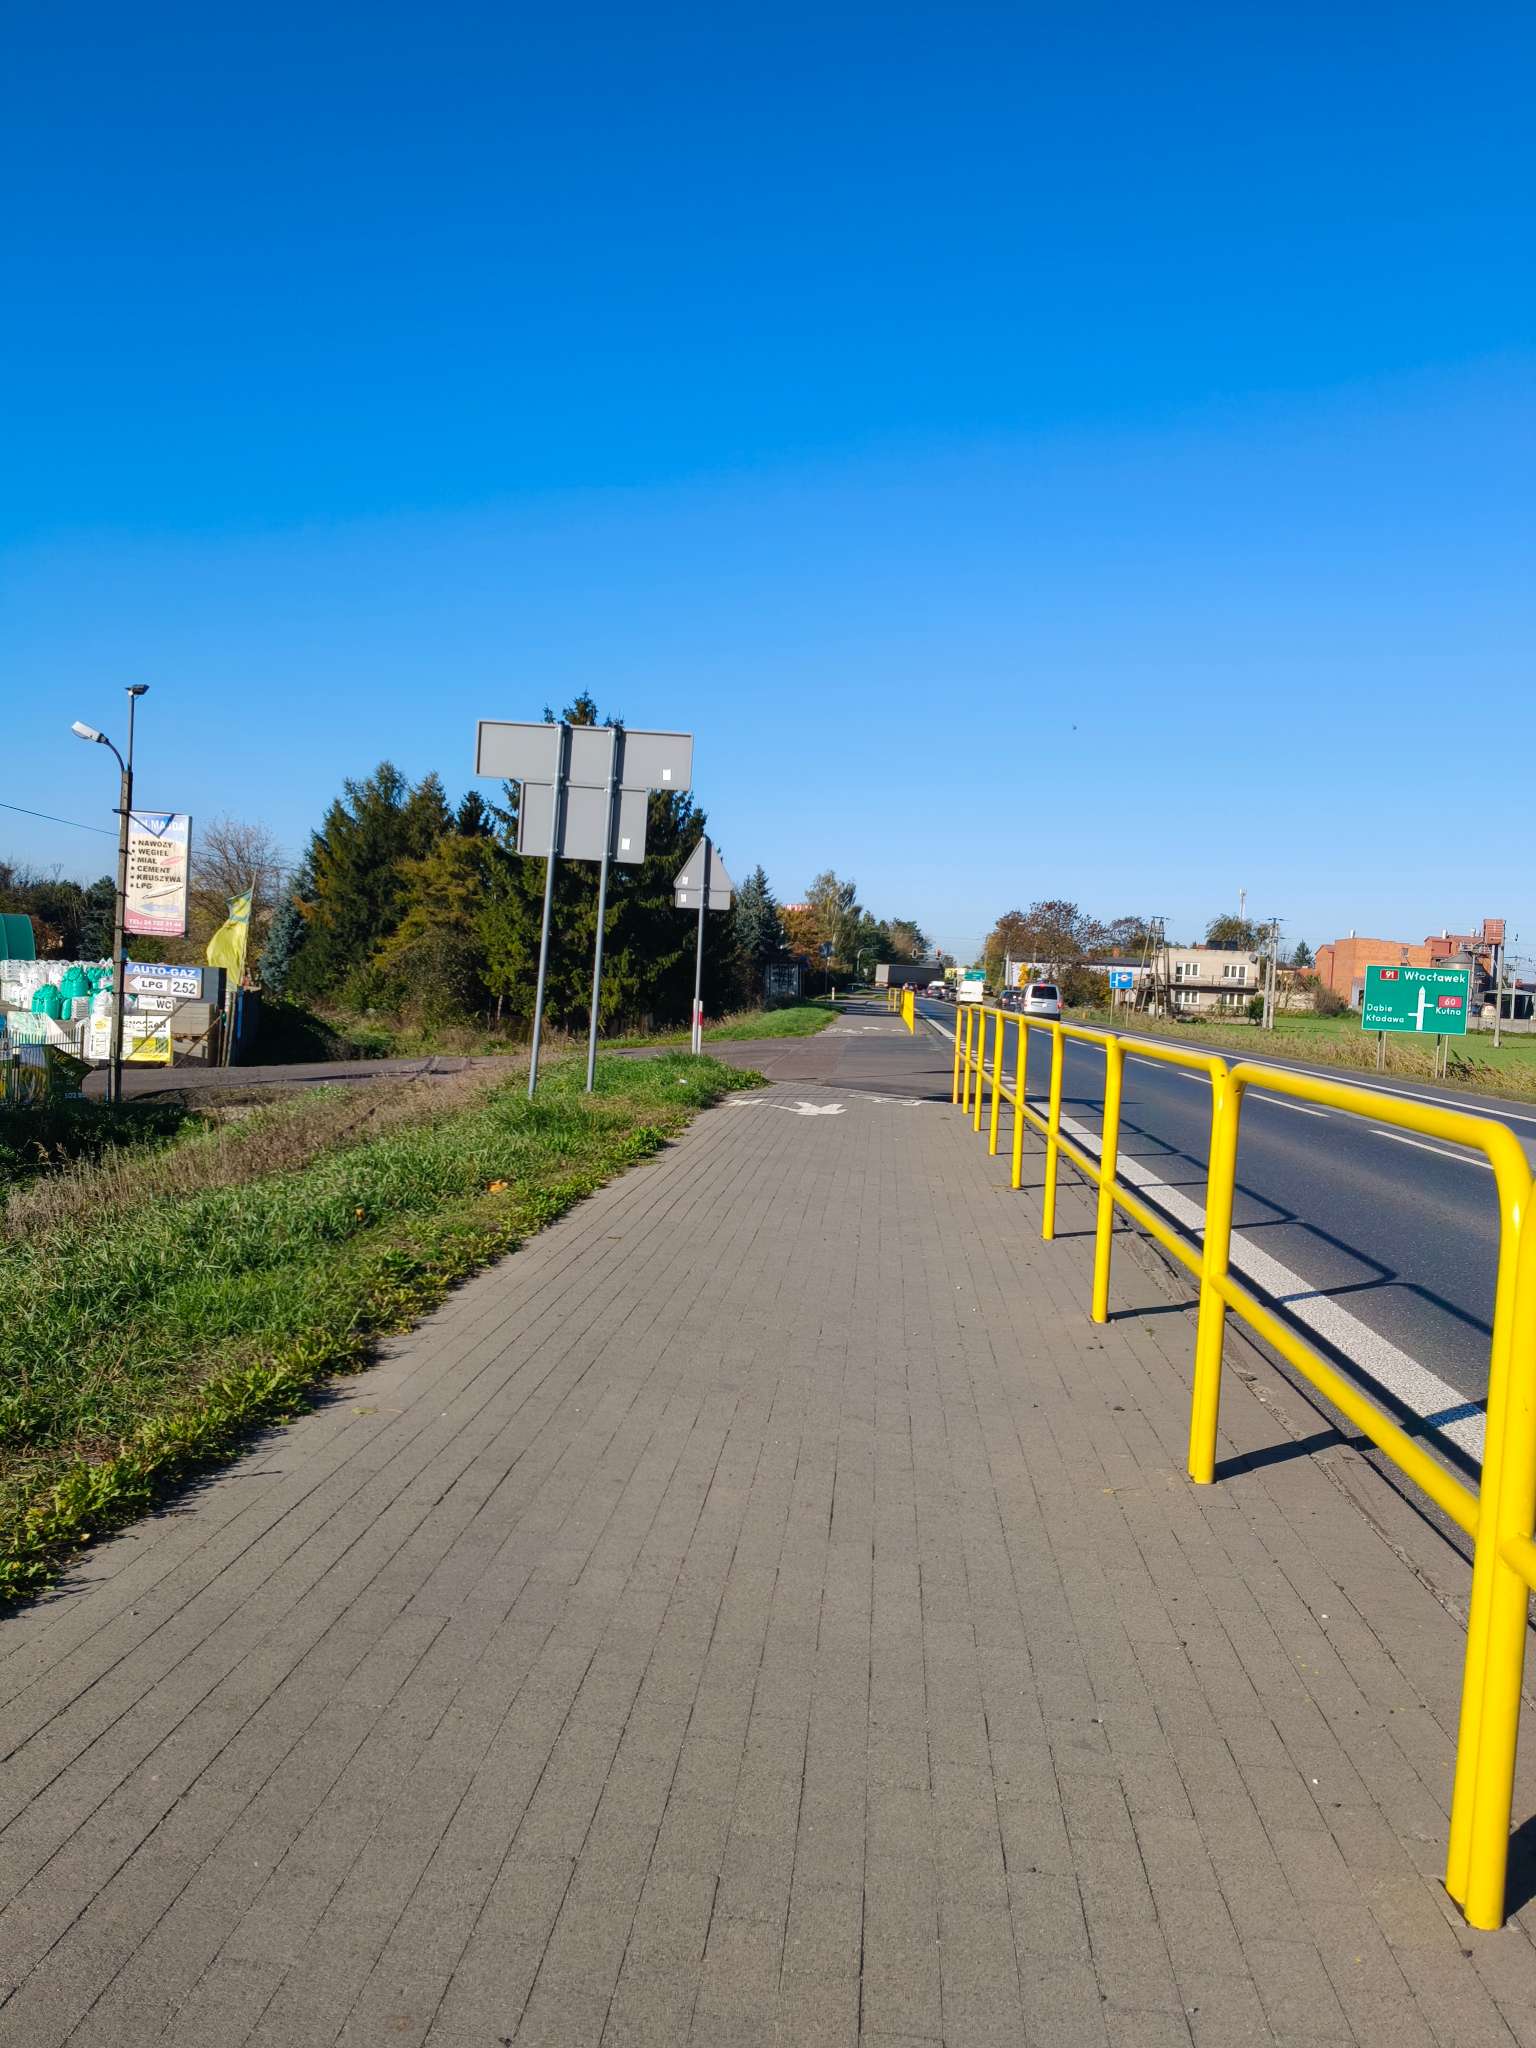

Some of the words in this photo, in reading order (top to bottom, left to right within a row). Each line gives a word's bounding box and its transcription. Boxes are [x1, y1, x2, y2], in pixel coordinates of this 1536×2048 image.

[138, 840, 173, 848] NAWOZY
[137, 866, 171, 874] CEMENT
[136, 874, 182, 882] KRUSZYWA
[132, 965, 196, 978] AUTO-GAZ
[1386, 970, 1394, 978] 91
[1404, 970, 1466, 983] Włocławek
[142, 980, 163, 988] LPG
[156, 1000, 172, 1009] WC
[1366, 1004, 1392, 1012] Dąbie
[1436, 1007, 1461, 1016] Kutno
[1366, 1014, 1404, 1022] Kłodawa
